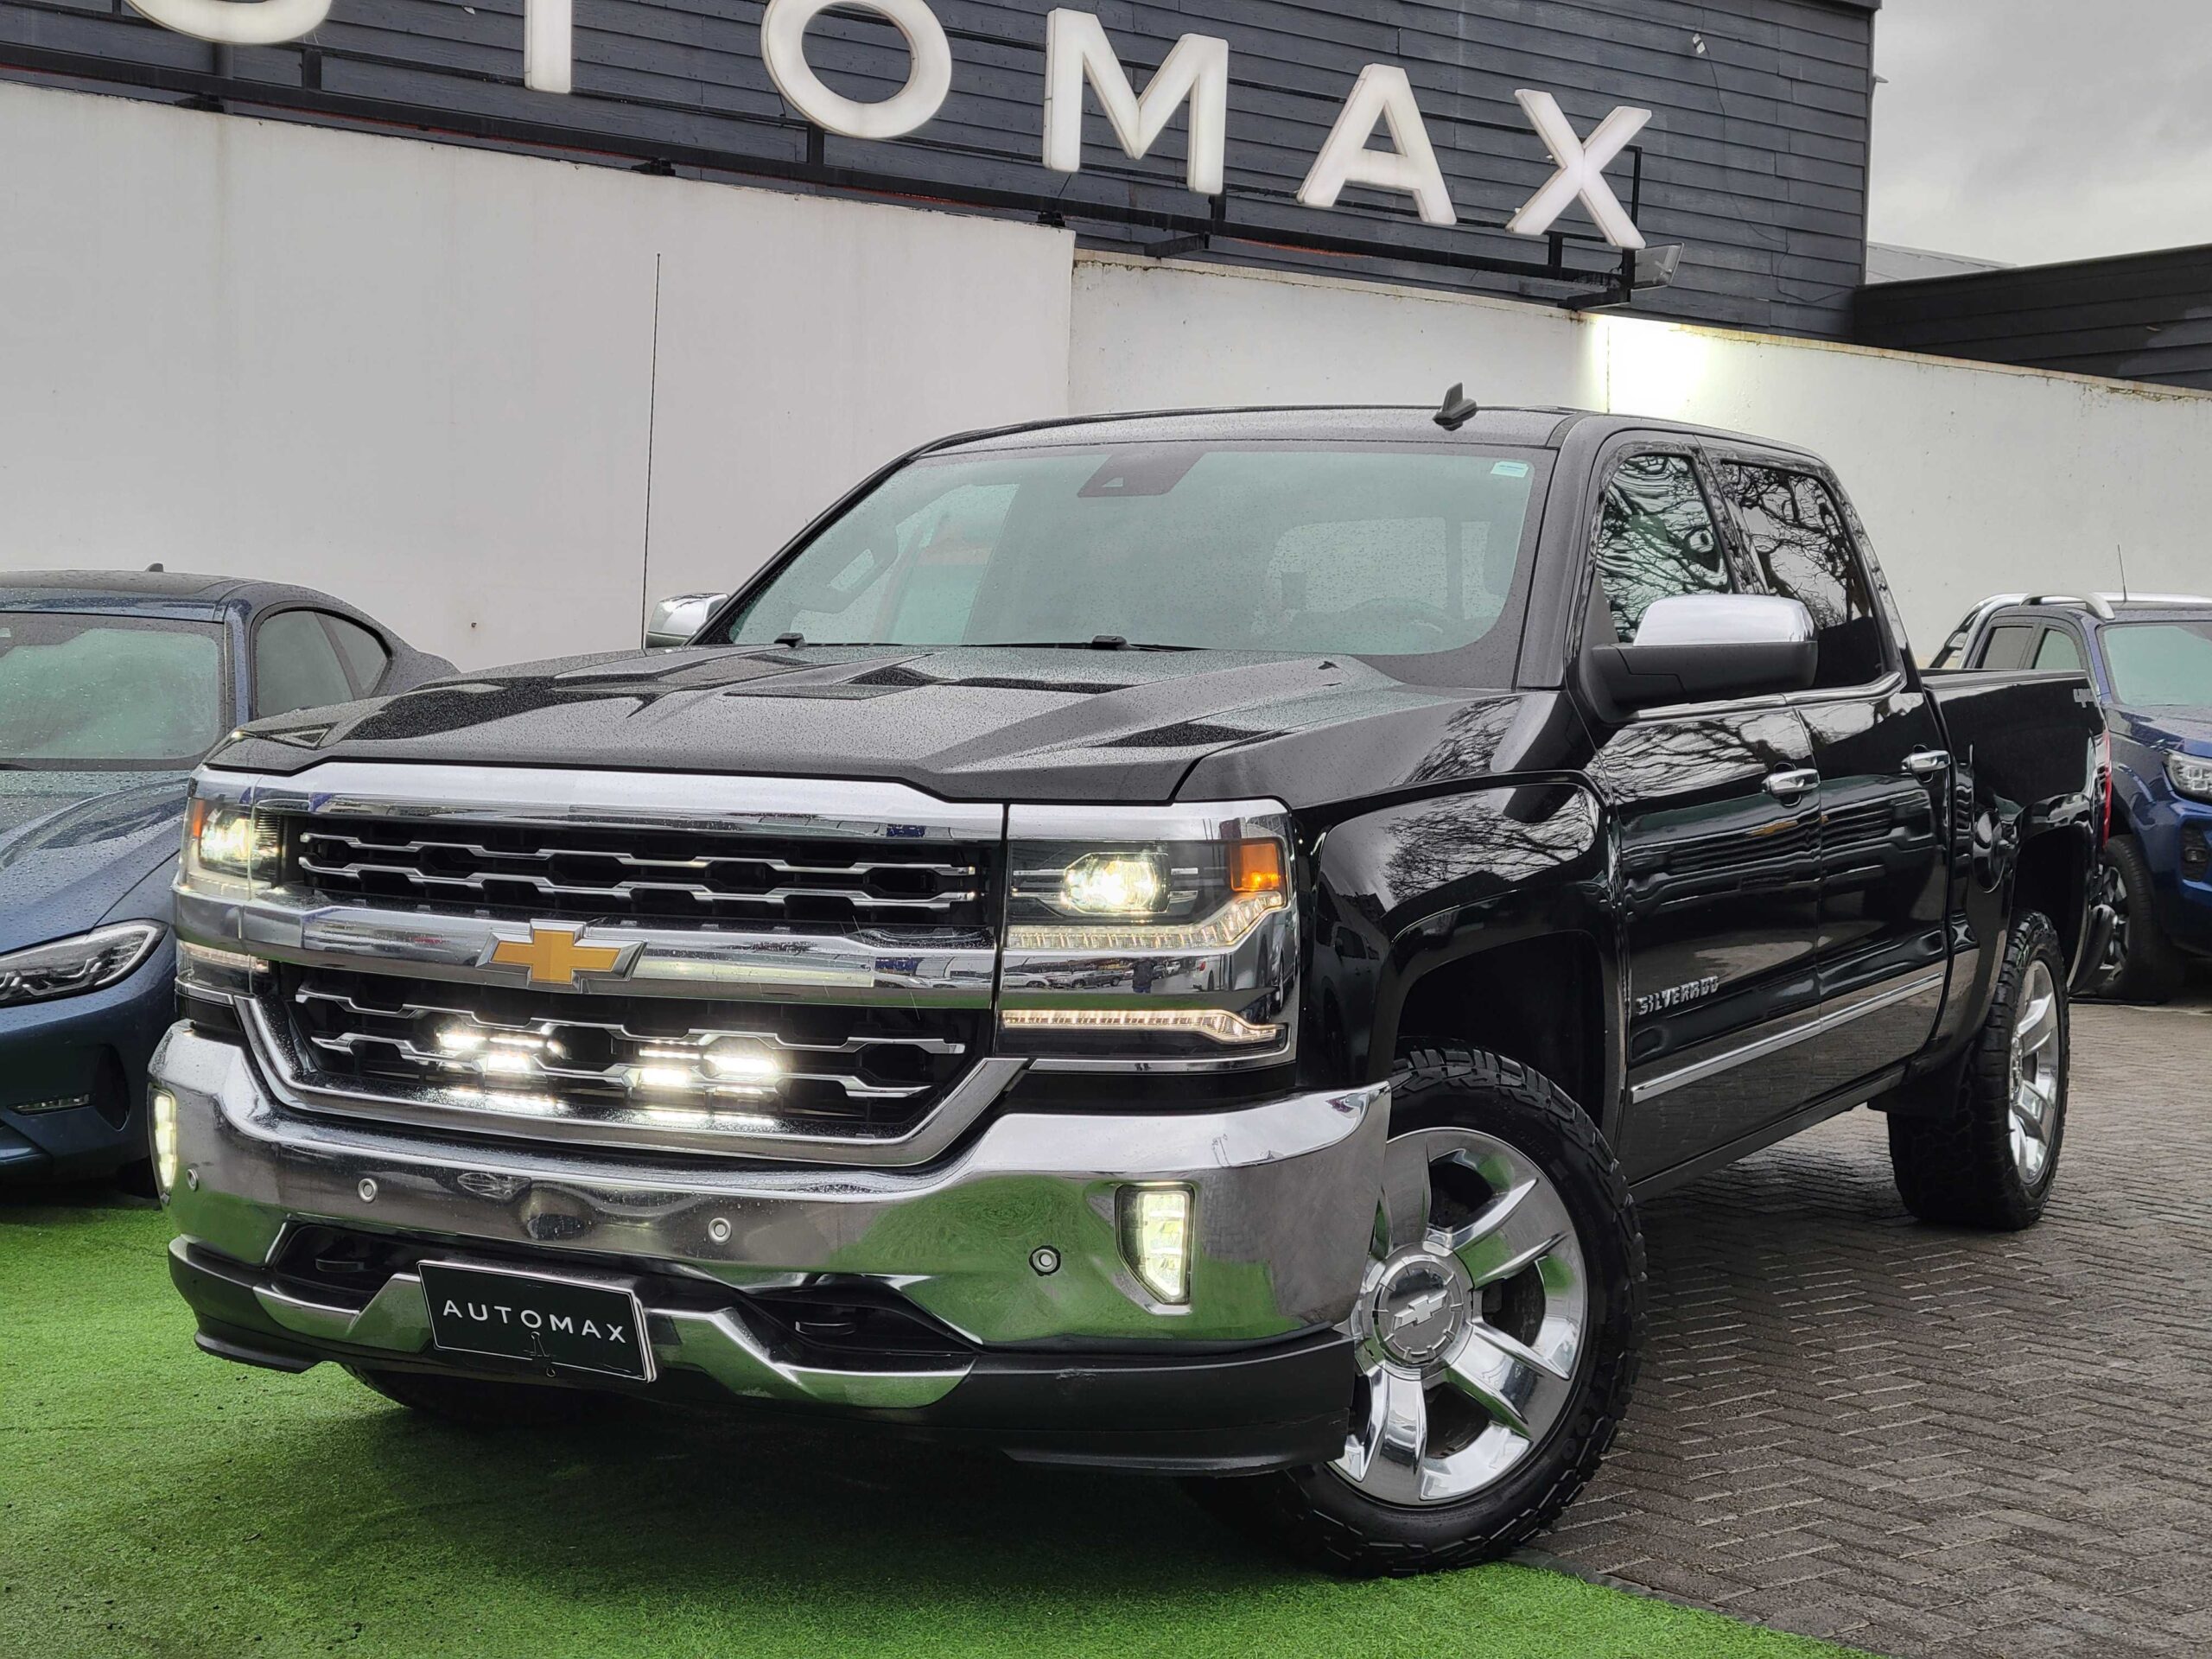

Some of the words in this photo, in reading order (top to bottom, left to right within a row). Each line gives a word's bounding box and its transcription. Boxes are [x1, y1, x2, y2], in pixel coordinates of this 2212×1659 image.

[125, 0, 1652, 249] OMAX
[1636, 976, 1719, 1016] SILVERADO
[442, 1300, 626, 1344] AUTOMAX
